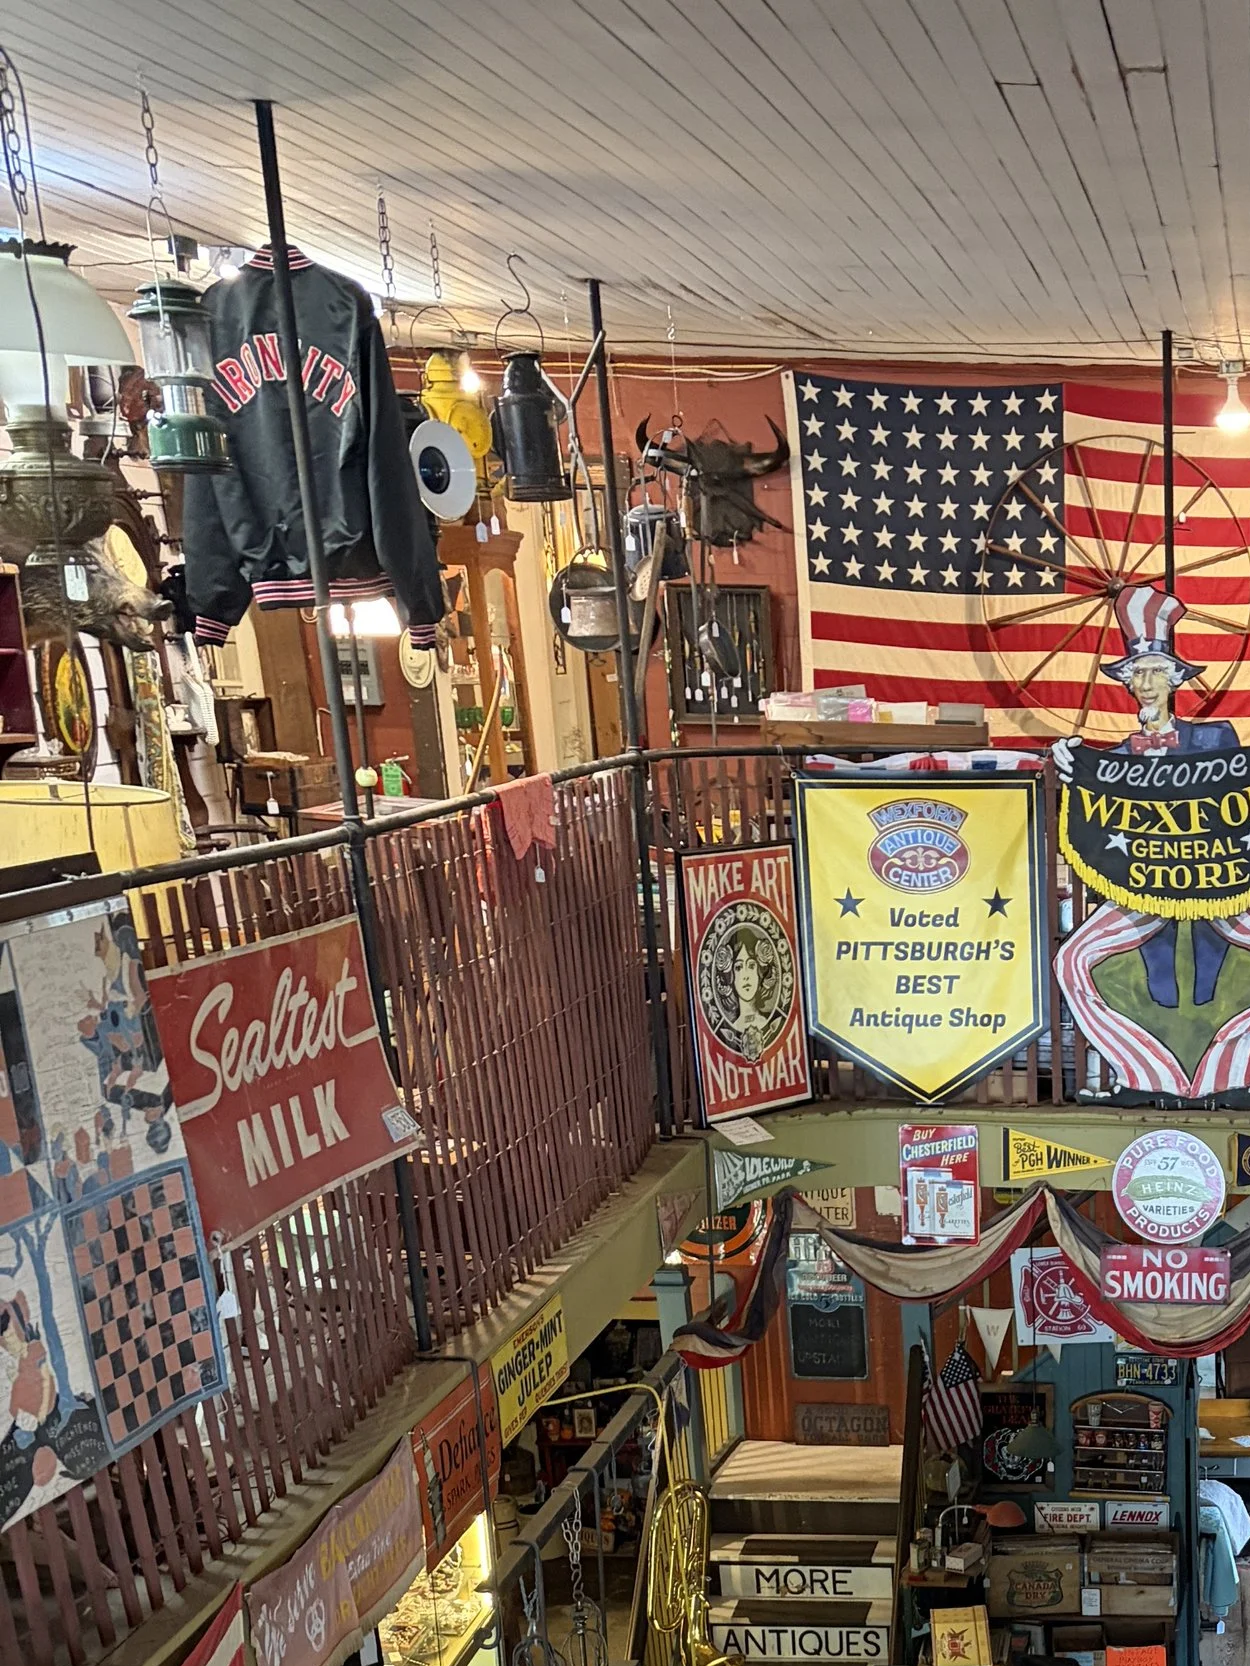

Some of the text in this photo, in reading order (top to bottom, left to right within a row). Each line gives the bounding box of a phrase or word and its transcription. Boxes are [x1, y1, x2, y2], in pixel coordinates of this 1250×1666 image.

[211, 333, 356, 417] IRON ITY
[1096, 753, 1248, 788] welcome
[873, 802, 964, 828] WEXFORD
[885, 829, 959, 855] ANTIQUE
[1132, 836, 1242, 860] GENERAL
[888, 866, 953, 888] CENTER
[1129, 858, 1250, 889] STORE
[686, 856, 791, 943] MAKE ART
[889, 907, 960, 928] Voted
[895, 974, 960, 995] BEST
[849, 1007, 1006, 1034] Antique Shop
[177, 957, 380, 1124] Sealtest
[702, 1013, 806, 1106] NOT WAR
[237, 1079, 350, 1188] MILK
[913, 1128, 937, 1142] BUY
[902, 1135, 976, 1162] CHESTERFIELD
[940, 1152, 970, 1167] HERE
[1019, 1151, 1044, 1169] PGH
[1046, 1145, 1090, 1169] WINNER
[1121, 1134, 1219, 1179] PURE FOOD
[1157, 1156, 1180, 1171] 57
[1141, 1181, 1199, 1195] HEINZ
[1126, 1206, 1212, 1239] PRODUCTS
[1142, 1204, 1195, 1216] VARIETIES
[1142, 1249, 1188, 1269] NO
[1104, 1270, 1228, 1301] SMOKING
[518, 1351, 553, 1408] JULEP
[1118, 1363, 1176, 1380] BHN 4733
[801, 1416, 889, 1433] OCTAGON
[446, 1478, 471, 1512] SPARK
[1044, 1513, 1092, 1523] FIRE DEPT.
[1112, 1510, 1163, 1522] LENNOX
[755, 1568, 853, 1595] MORE
[1015, 1581, 1056, 1591] CANADA
[1024, 1591, 1046, 1600] DRY
[723, 1629, 881, 1657] ANTIQUES
